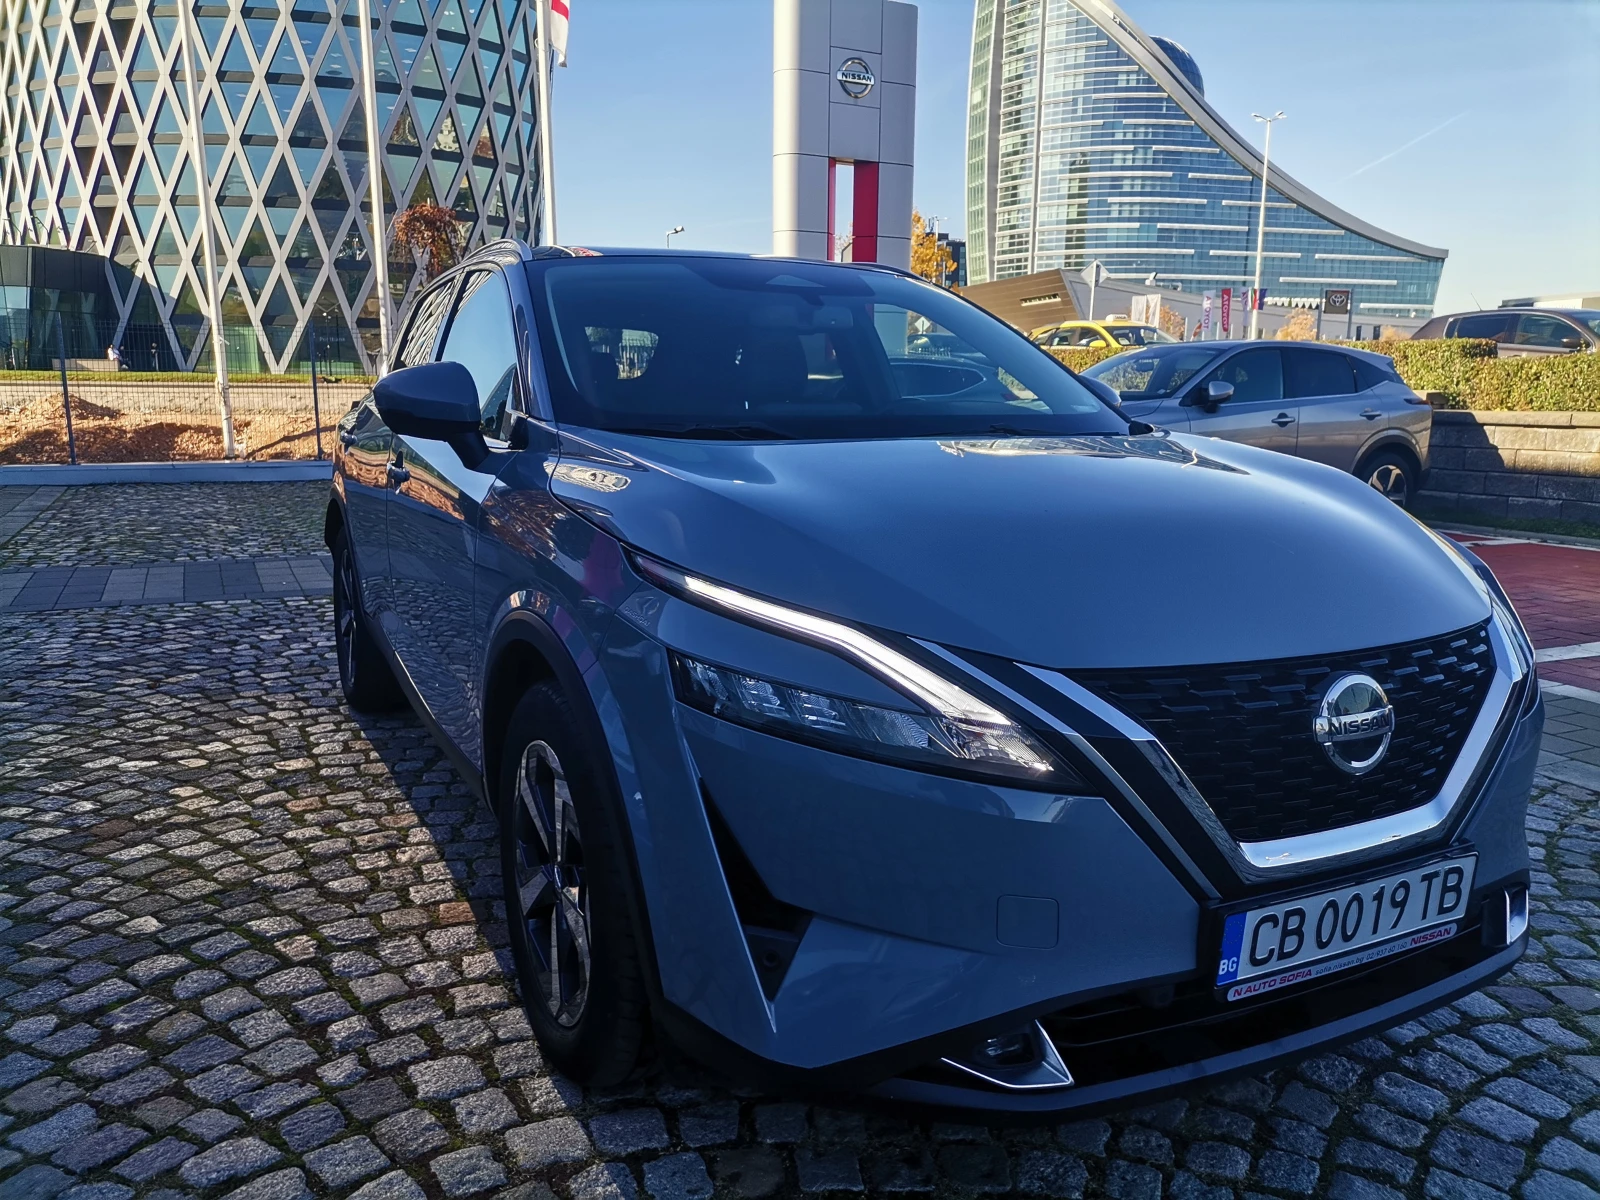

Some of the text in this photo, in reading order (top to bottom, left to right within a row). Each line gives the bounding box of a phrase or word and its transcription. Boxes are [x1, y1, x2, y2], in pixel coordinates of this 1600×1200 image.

[842, 72, 872, 82] NISSAN
[1330, 712, 1390, 736] NISSAN
[1249, 865, 1464, 967] CB 0019 TB
[1218, 957, 1238, 975] BG
[1233, 988, 1243, 997] N
[1243, 979, 1277, 994] AUTO
[1279, 969, 1312, 985] SOFIA
[1315, 956, 1364, 975] sofia.nissan.bg
[1410, 927, 1452, 946] NISSAN
